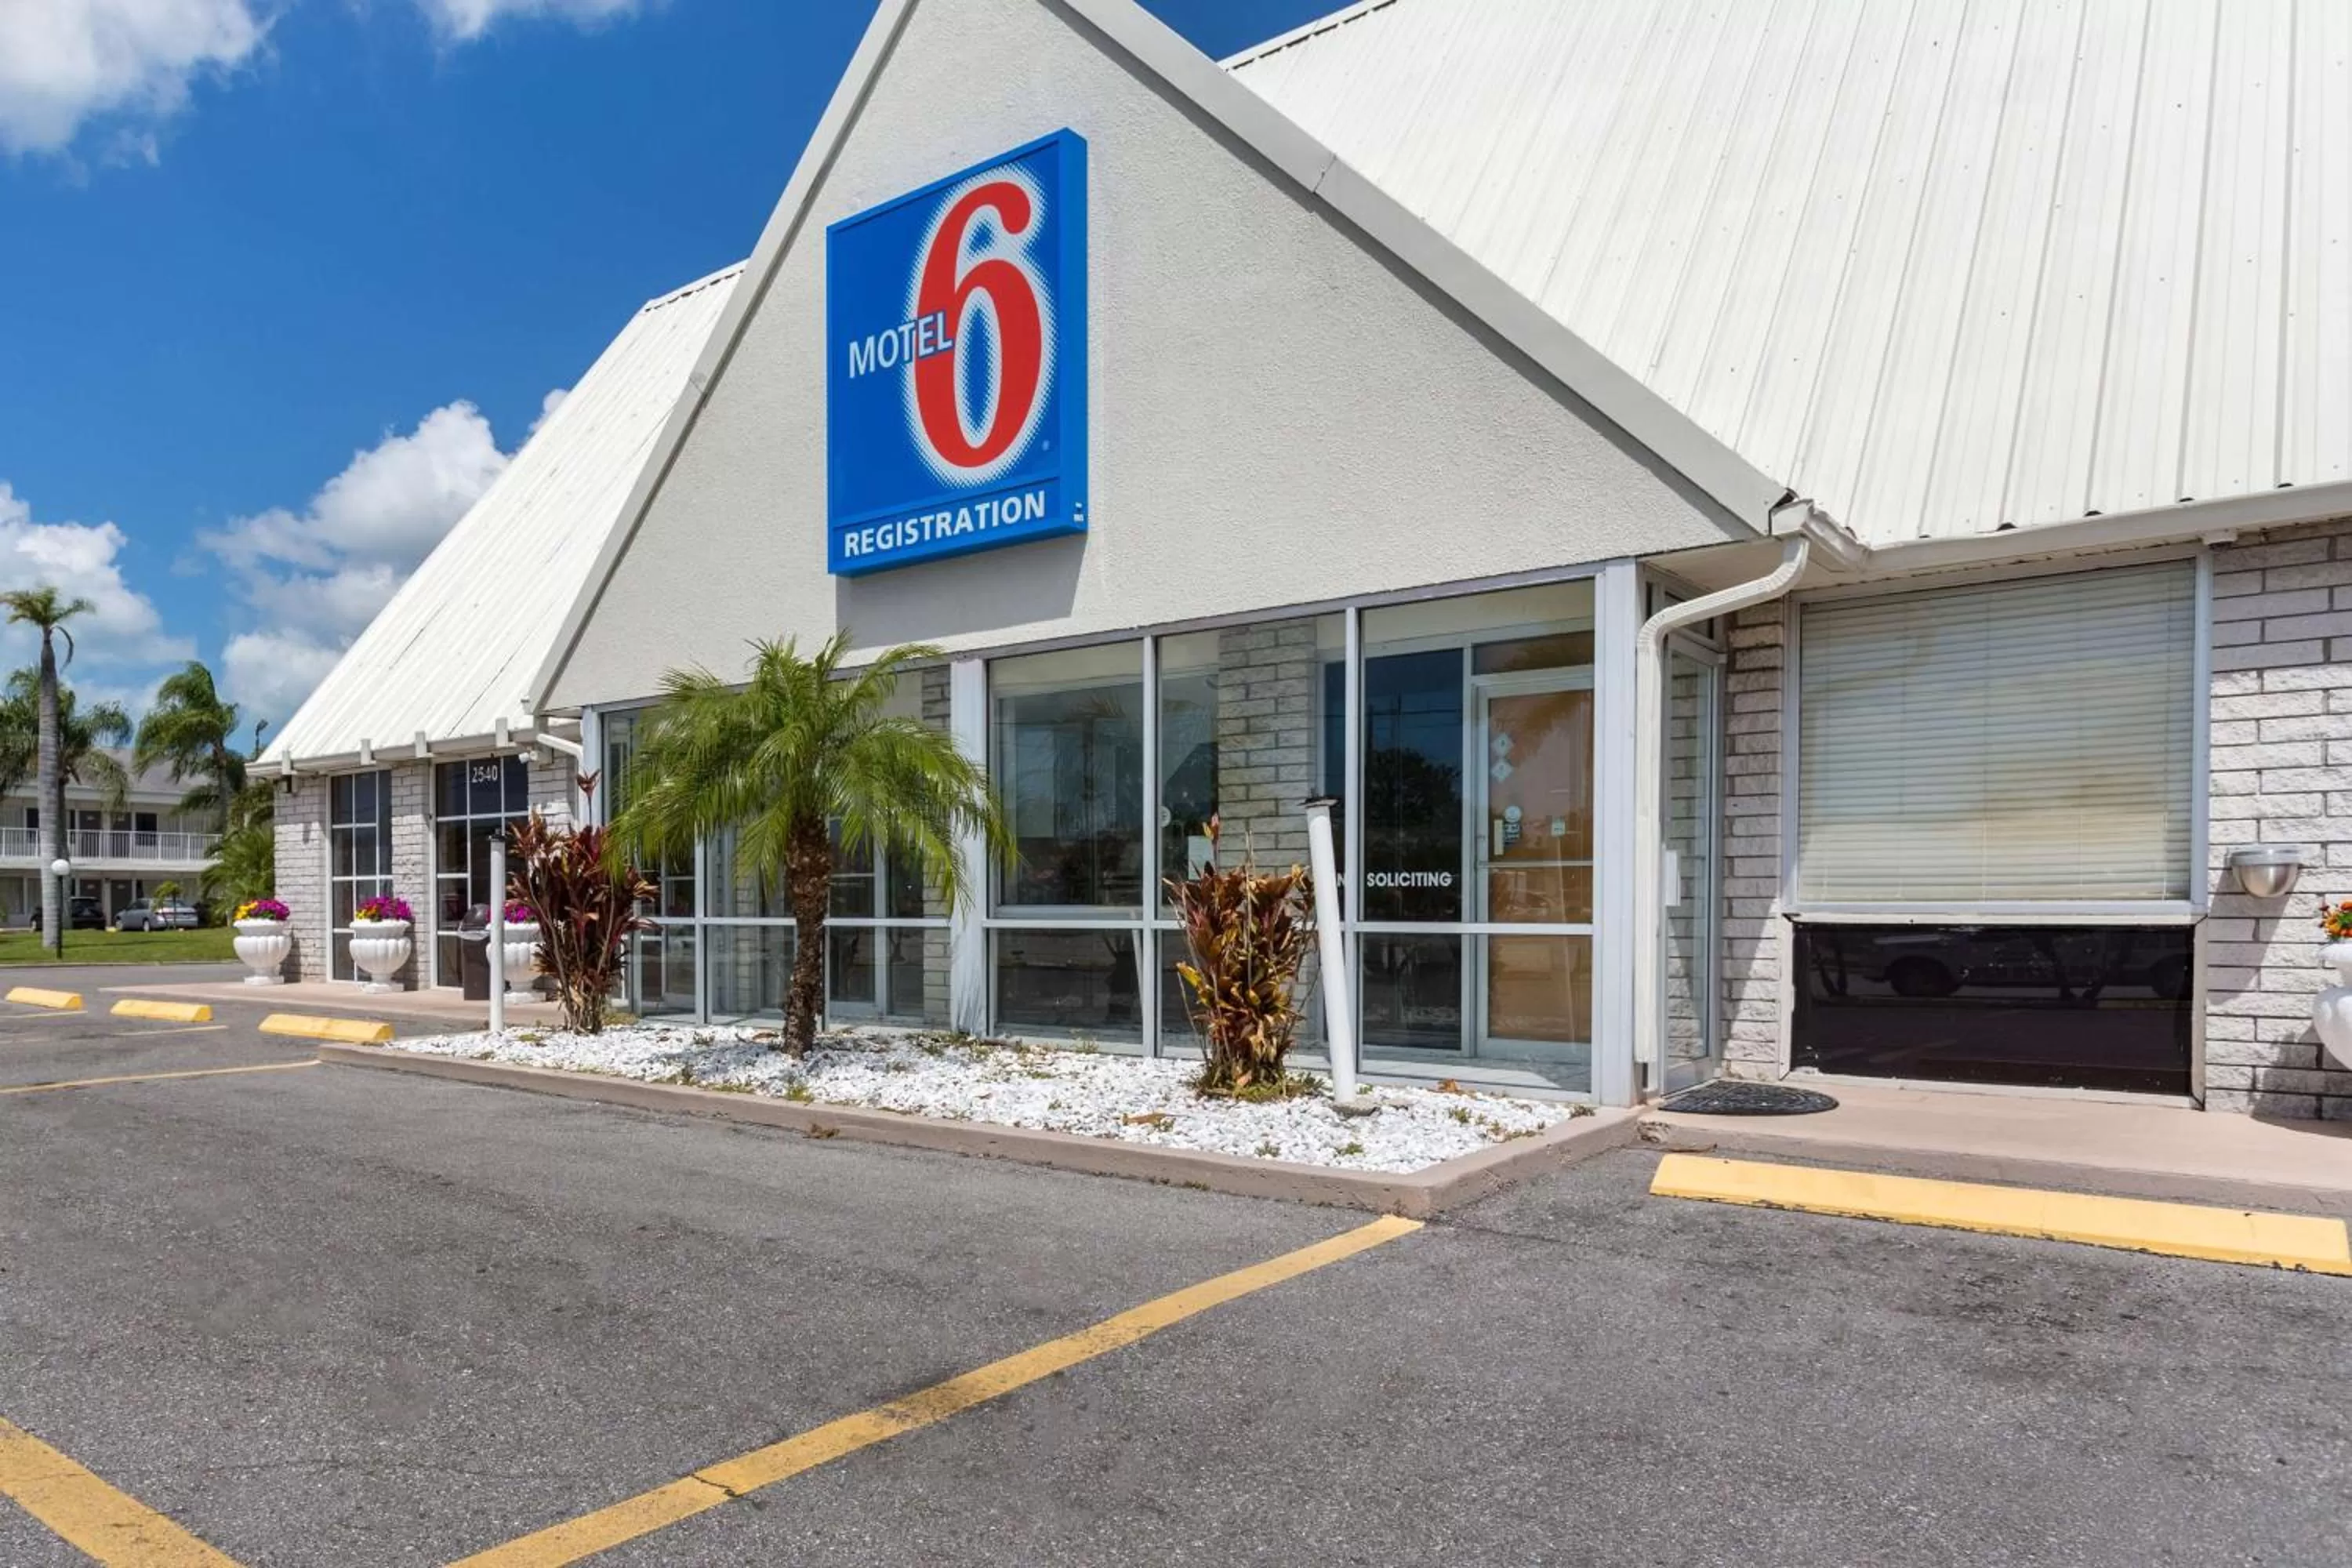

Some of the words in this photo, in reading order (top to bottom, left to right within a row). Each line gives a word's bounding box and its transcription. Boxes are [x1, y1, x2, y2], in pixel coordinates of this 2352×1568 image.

[849, 311, 953, 379] MOTEL
[914, 180, 1043, 469] 6
[844, 490, 1046, 557] REGISTRATION
[472, 764, 498, 783] 2540
[1367, 871, 1453, 887] SOLICITING
